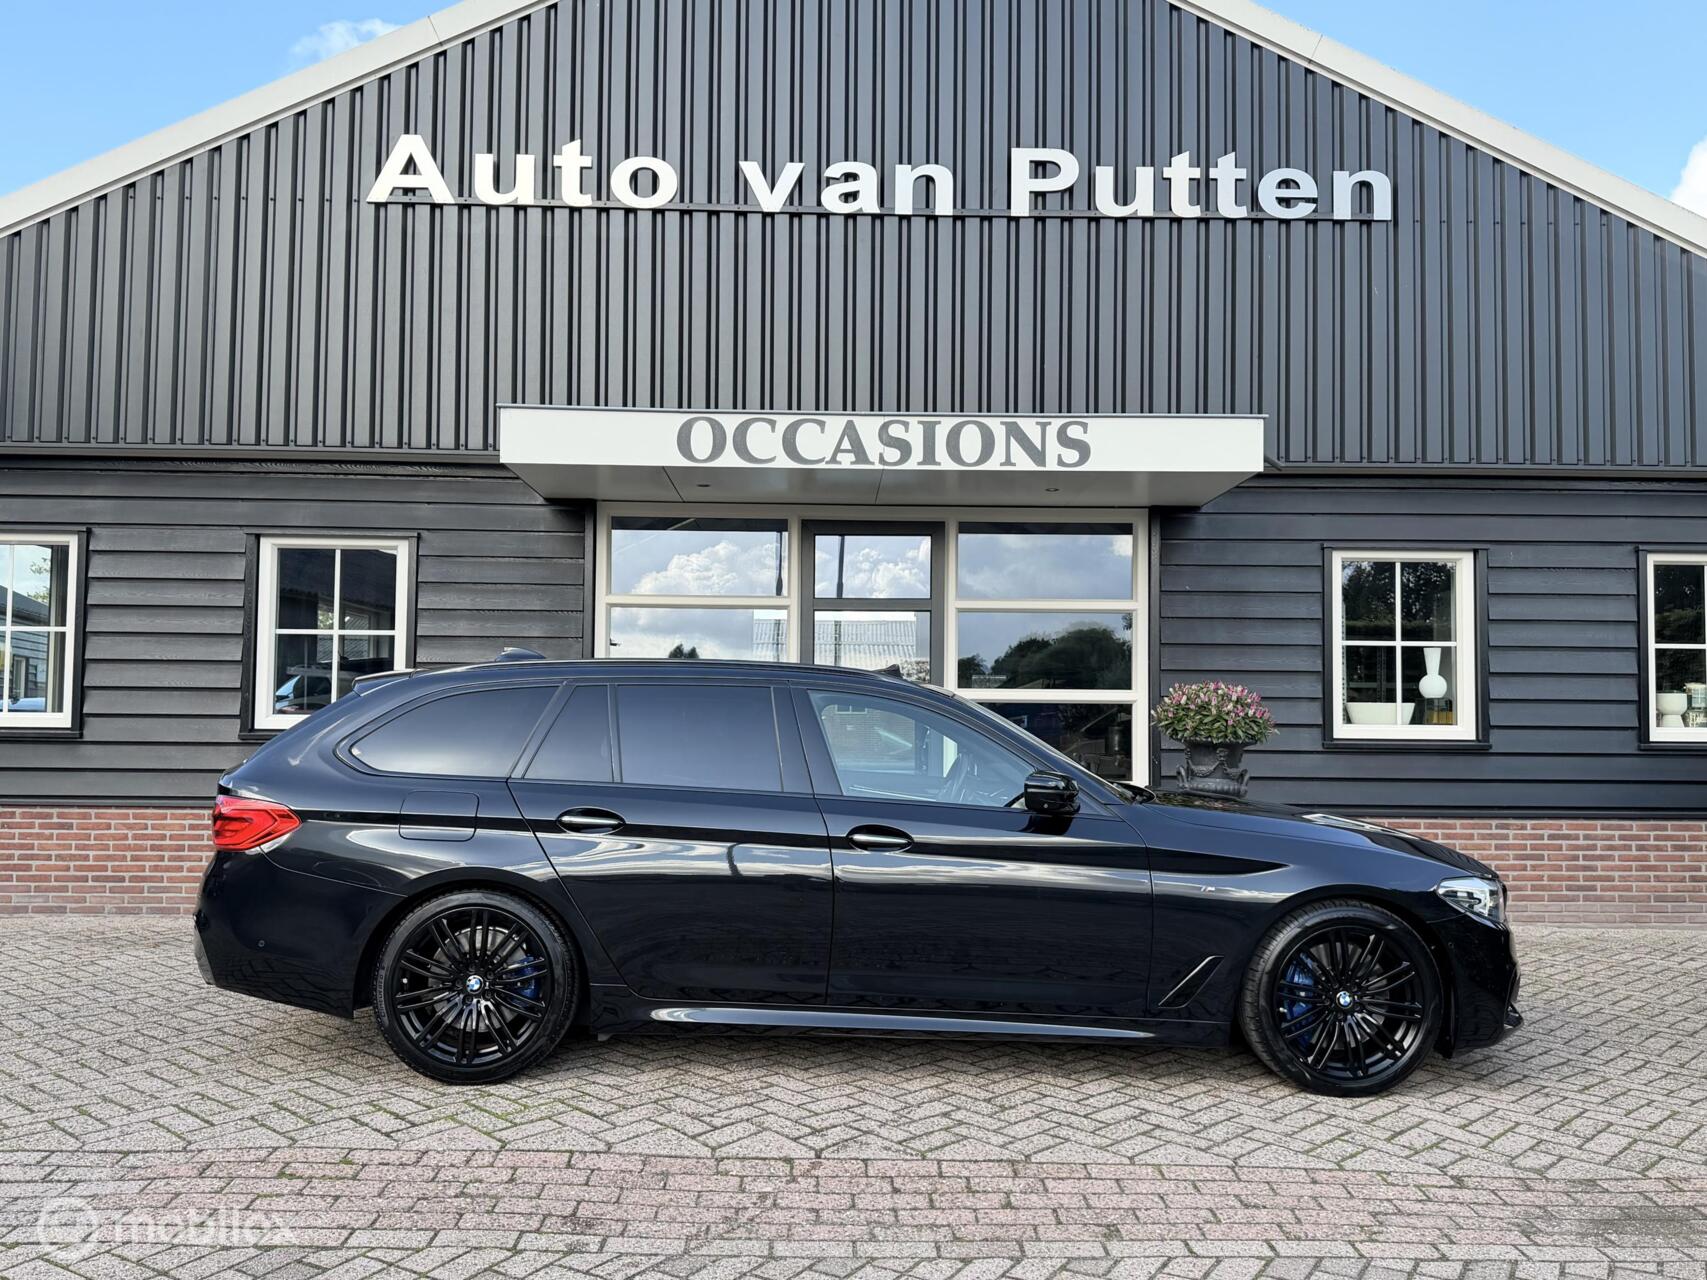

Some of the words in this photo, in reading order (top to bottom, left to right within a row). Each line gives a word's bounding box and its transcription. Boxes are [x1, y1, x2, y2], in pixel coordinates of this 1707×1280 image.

[366, 133, 678, 209] Auto
[738, 160, 954, 216] van
[1010, 147, 1393, 221] Putten
[676, 416, 1091, 472] OCCASIONS
